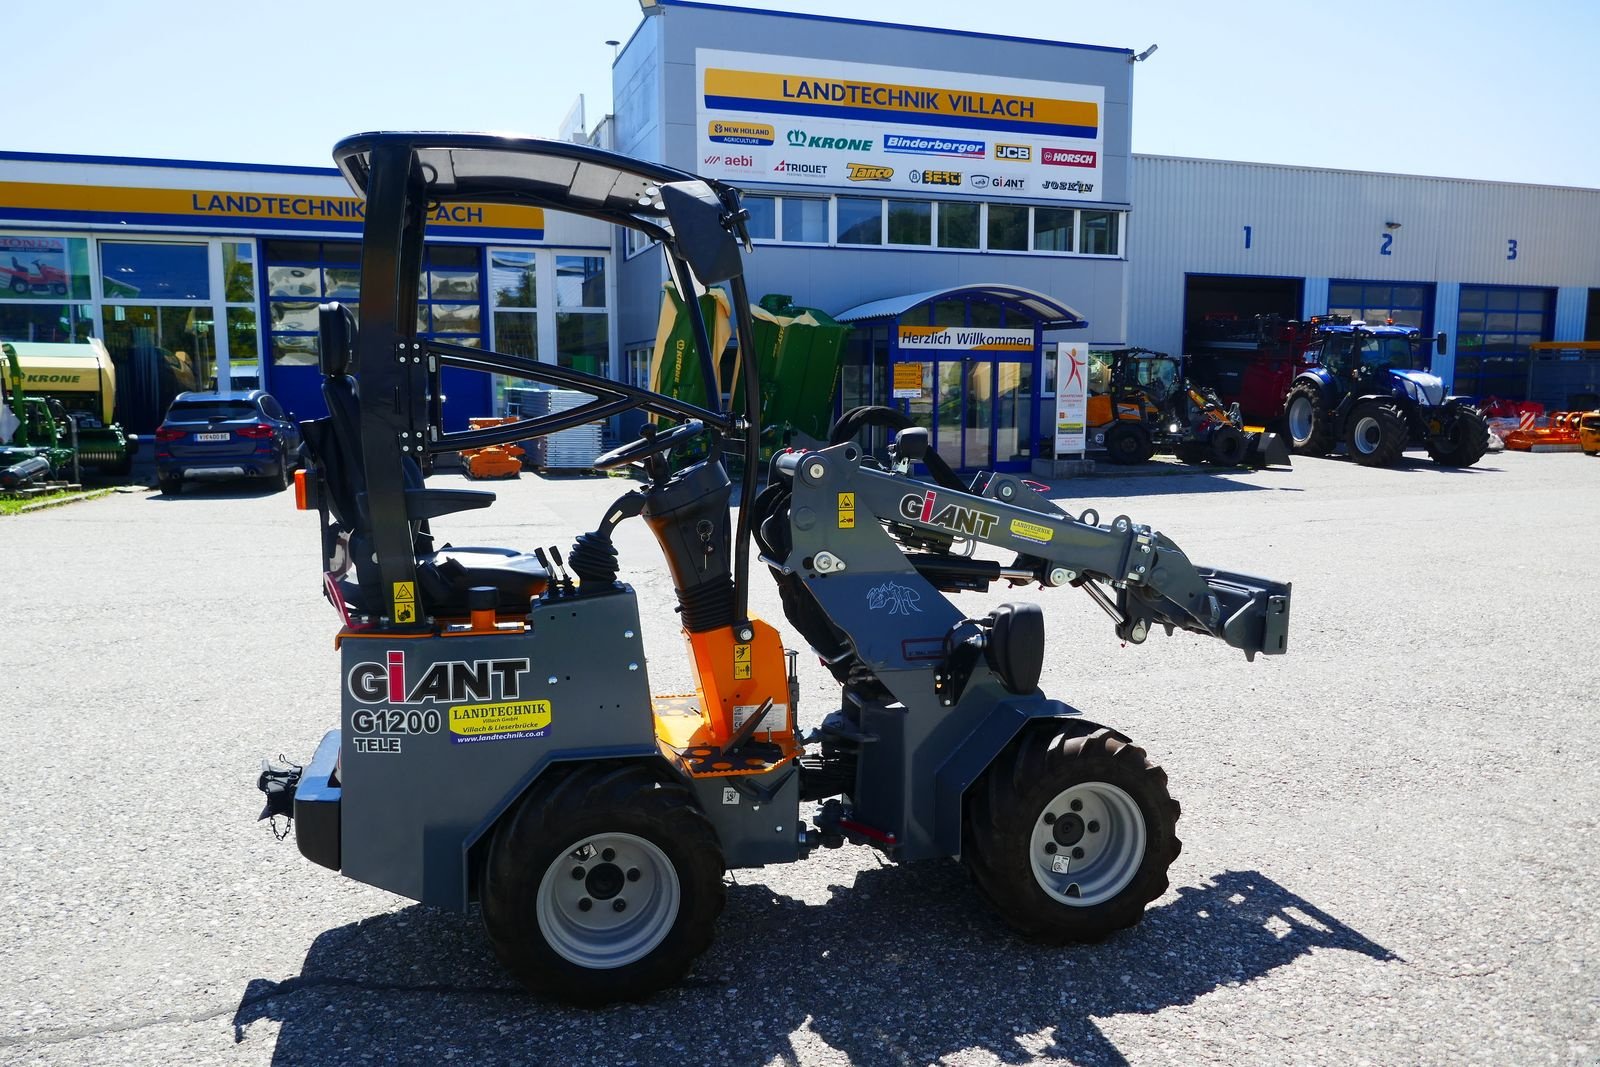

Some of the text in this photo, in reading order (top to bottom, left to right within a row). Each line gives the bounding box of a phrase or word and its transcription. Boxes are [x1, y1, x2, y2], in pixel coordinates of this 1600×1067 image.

[782, 79, 1034, 118] LANDTECHNIK VILLACH
[724, 126, 769, 136] NEW HOLLAND
[723, 137, 759, 145] AGRICULTURE
[808, 136, 873, 151] KRONE
[887, 137, 982, 153] Binderberger
[997, 146, 1029, 159] JCB
[1053, 153, 1093, 164] HORSCH
[725, 155, 753, 167] aebi
[785, 163, 827, 174] TRIOLIET
[847, 163, 894, 180] Tanco
[192, 194, 365, 218] LANDTECHNIK
[1243, 226, 1251, 249] 1
[1380, 233, 1392, 255] 2
[1507, 239, 1517, 260] 3
[902, 332, 1031, 346] Herzlich Willkommen
[674, 350, 682, 383] KRONE
[27, 374, 80, 383] KRONE
[453, 703, 546, 720] LANDTECHNIK
[351, 709, 441, 735] G1200
[494, 722, 539, 731] Lieserbrücke
[457, 730, 545, 743] www.landtechnik.co.at
[353, 738, 402, 753] TELE
